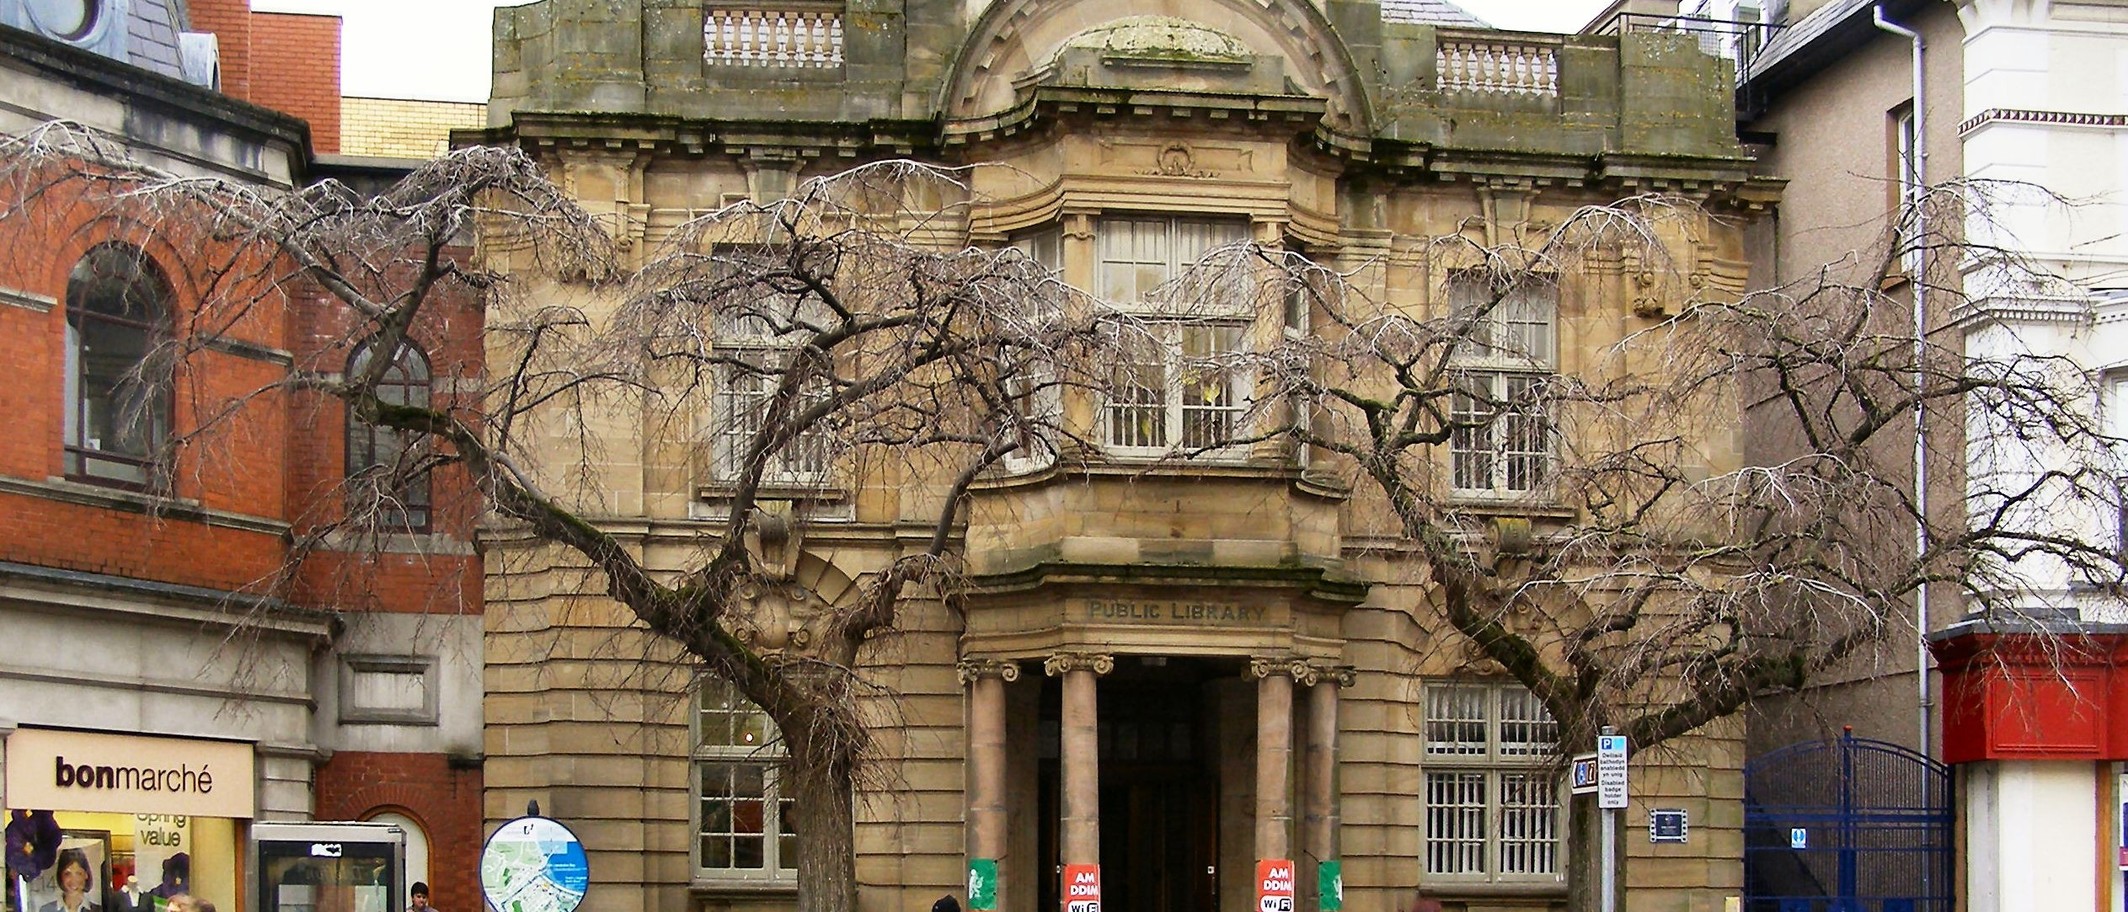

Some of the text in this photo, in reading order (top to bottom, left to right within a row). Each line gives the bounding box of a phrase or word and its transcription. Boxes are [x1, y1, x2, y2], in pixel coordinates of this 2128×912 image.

[1088, 601, 1266, 621] PUBLIC LIBRARY
[55, 756, 213, 794] bonmarché
[140, 827, 181, 847] value
[1075, 872, 1095, 883] AM
[1269, 867, 1289, 879] AM
[1070, 885, 1098, 896] DDIM
[1263, 880, 1292, 891] DDIM
